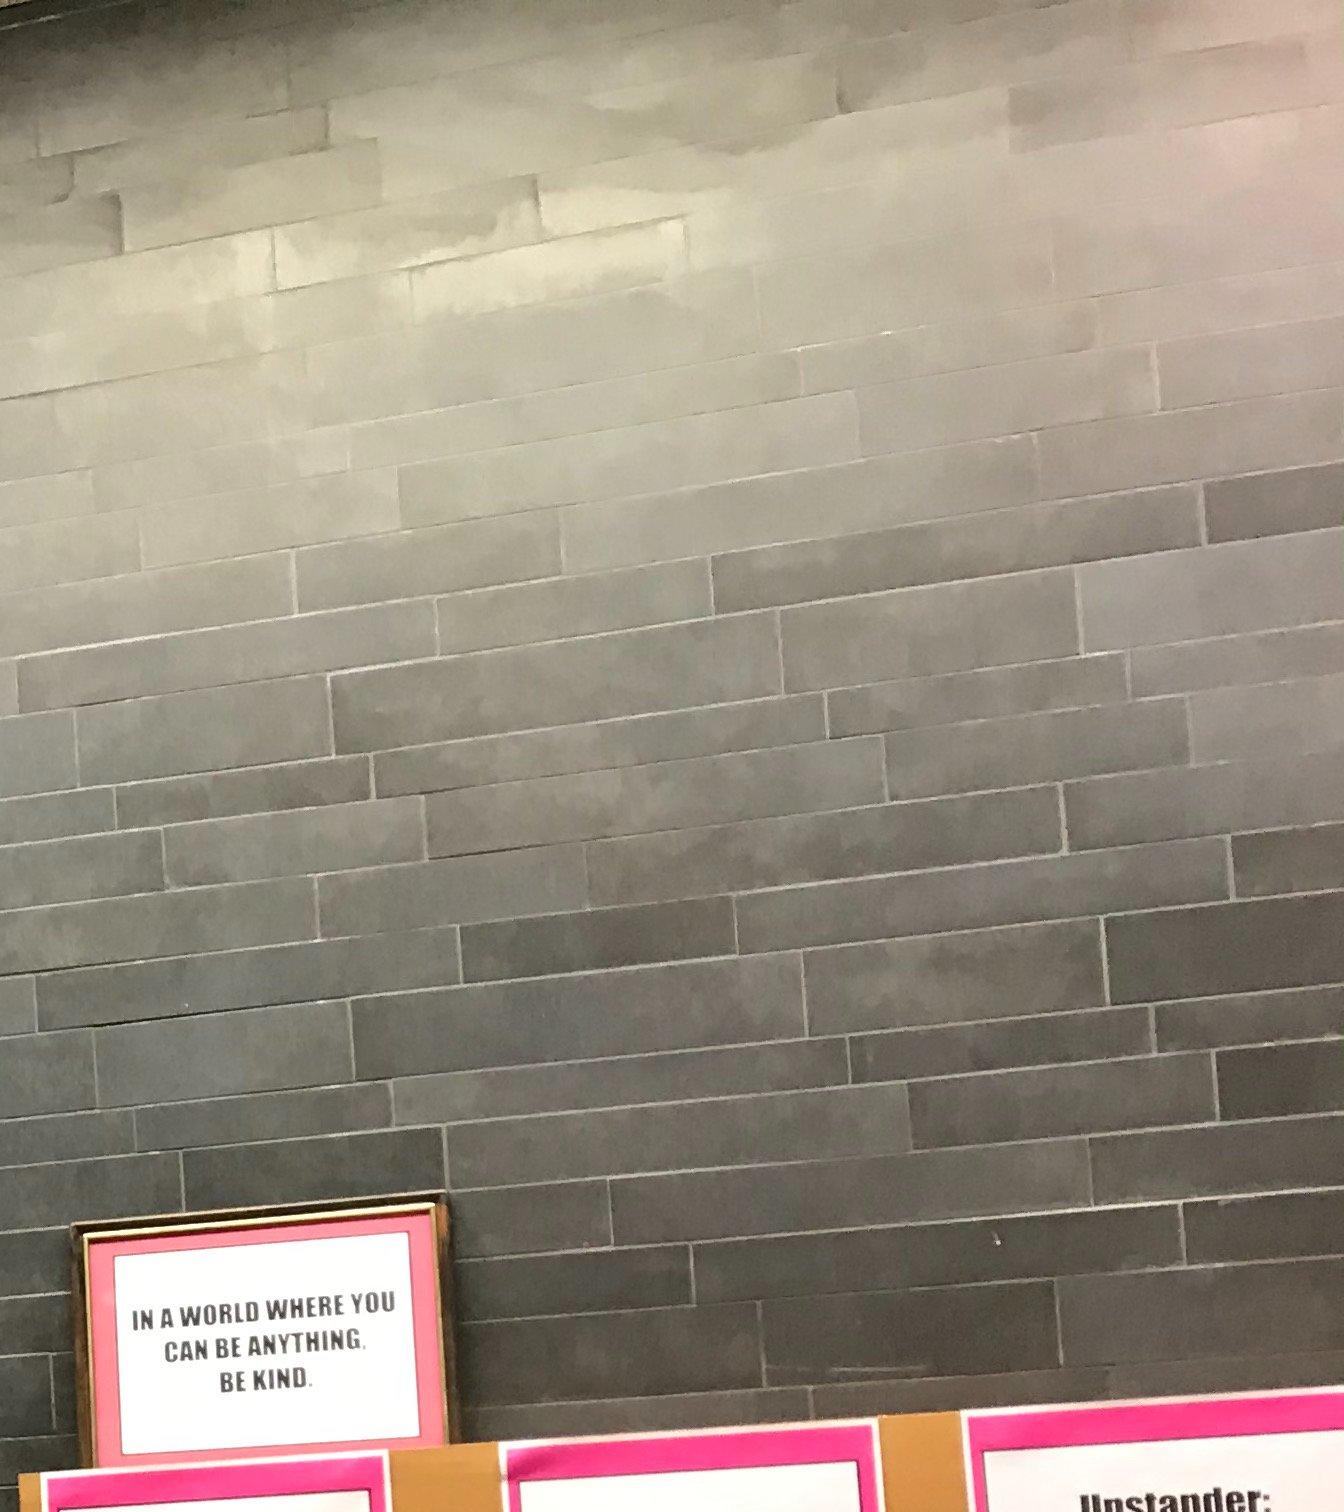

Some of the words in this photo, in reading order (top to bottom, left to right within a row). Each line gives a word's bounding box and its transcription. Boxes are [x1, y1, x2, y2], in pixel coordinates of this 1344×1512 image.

[132, 1309, 153, 1331] IN
[160, 1308, 174, 1329] A
[180, 1300, 260, 1327] WORLD
[265, 1295, 344, 1320] WHERE
[351, 1290, 396, 1314] YOU
[164, 1338, 209, 1363] CAN
[215, 1337, 241, 1359] BE
[220, 1369, 246, 1393] BE
[253, 1366, 313, 1391] KIND.
